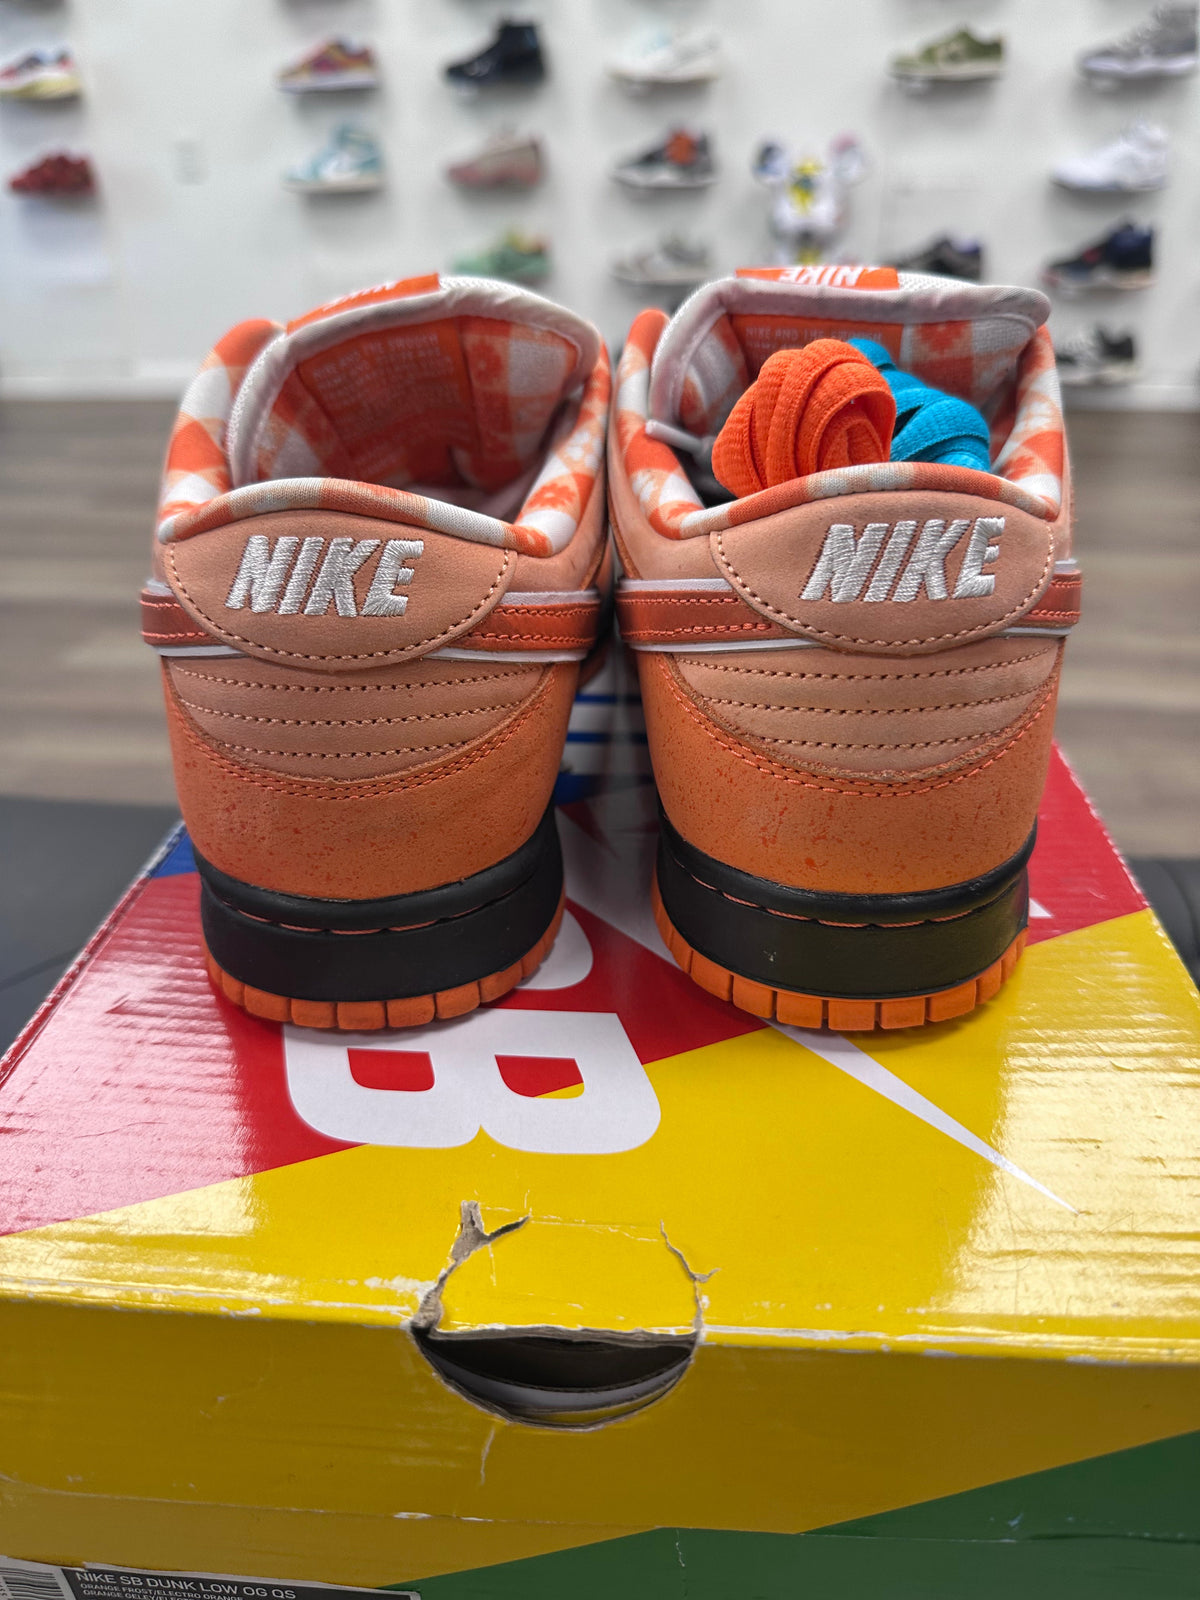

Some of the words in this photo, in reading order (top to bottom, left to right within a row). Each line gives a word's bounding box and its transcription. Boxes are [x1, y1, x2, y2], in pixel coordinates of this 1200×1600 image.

[801, 517, 1006, 603] NIKE
[224, 535, 425, 618] NIKE
[75, 1572, 117, 1584] NIKE
[119, 1575, 143, 1586] SB
[145, 1578, 197, 1591] DUNK
[199, 1582, 238, 1595] LOW
[242, 1586, 269, 1597] OG
[271, 1588, 297, 1600] QS
[80, 1582, 122, 1592] ORANGE
[122, 1587, 201, 1599] FROST/ELECTRO
[82, 1589, 125, 1598] ORANGE
